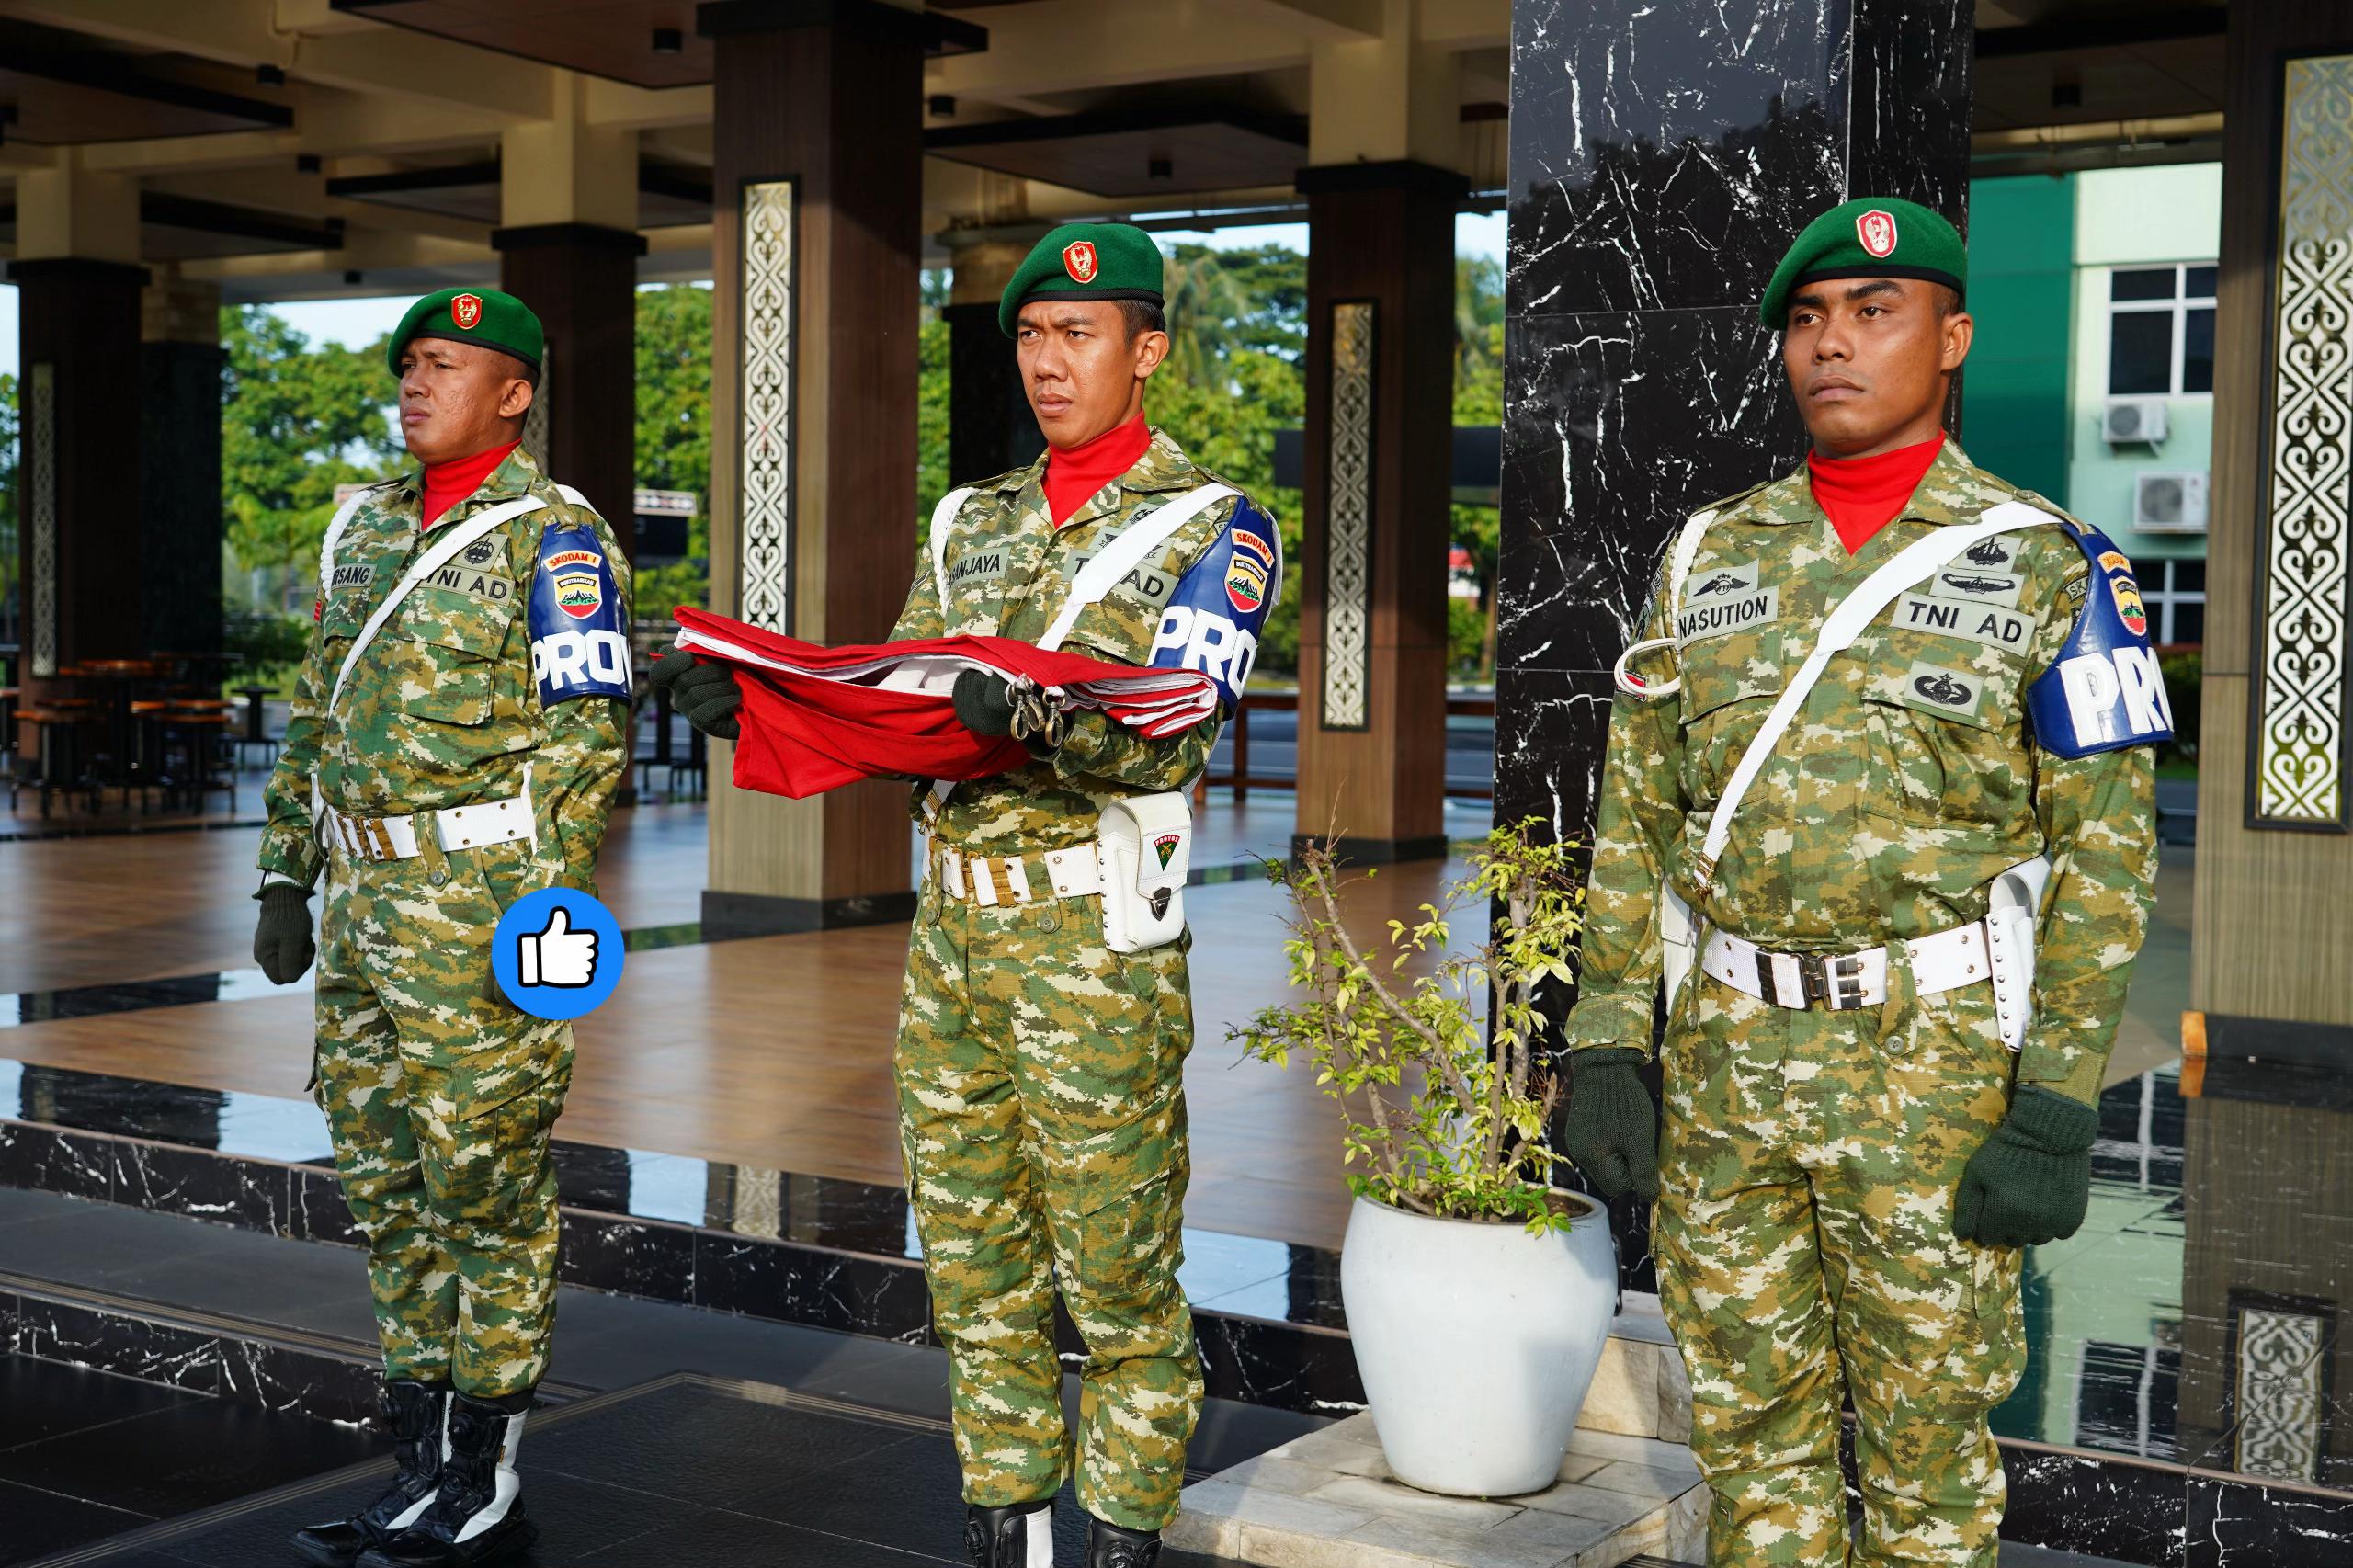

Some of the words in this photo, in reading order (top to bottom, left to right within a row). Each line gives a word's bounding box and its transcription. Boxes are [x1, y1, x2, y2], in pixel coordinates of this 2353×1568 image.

[1237, 532, 1268, 556] SKODAM
[550, 552, 588, 566] SKODAM
[469, 575, 507, 599] AD
[1120, 568, 1165, 597] AD
[1678, 596, 1768, 641] NASUTION
[1908, 600, 1960, 629] TNI
[1975, 613, 2022, 643] AD
